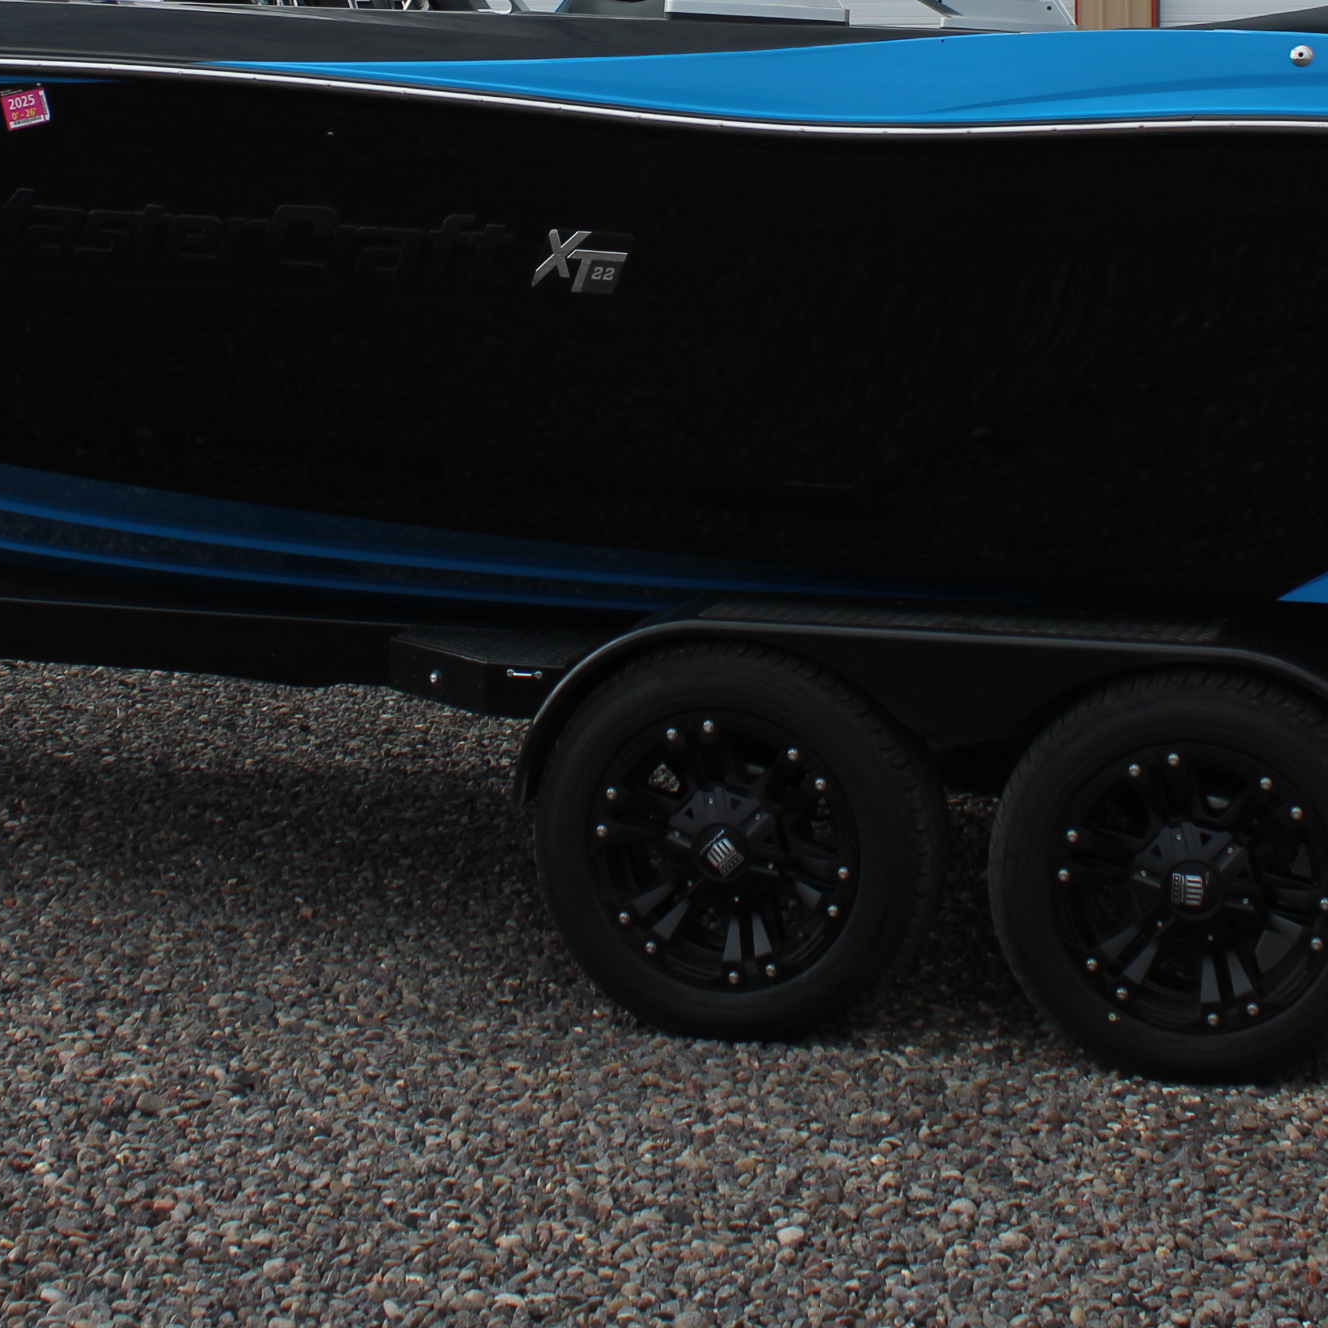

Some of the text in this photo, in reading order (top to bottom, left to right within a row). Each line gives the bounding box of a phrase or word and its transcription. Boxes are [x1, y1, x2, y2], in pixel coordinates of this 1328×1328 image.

[8, 93, 36, 111] 2025
[531, 229, 628, 293] XT
[591, 266, 616, 281] 22
